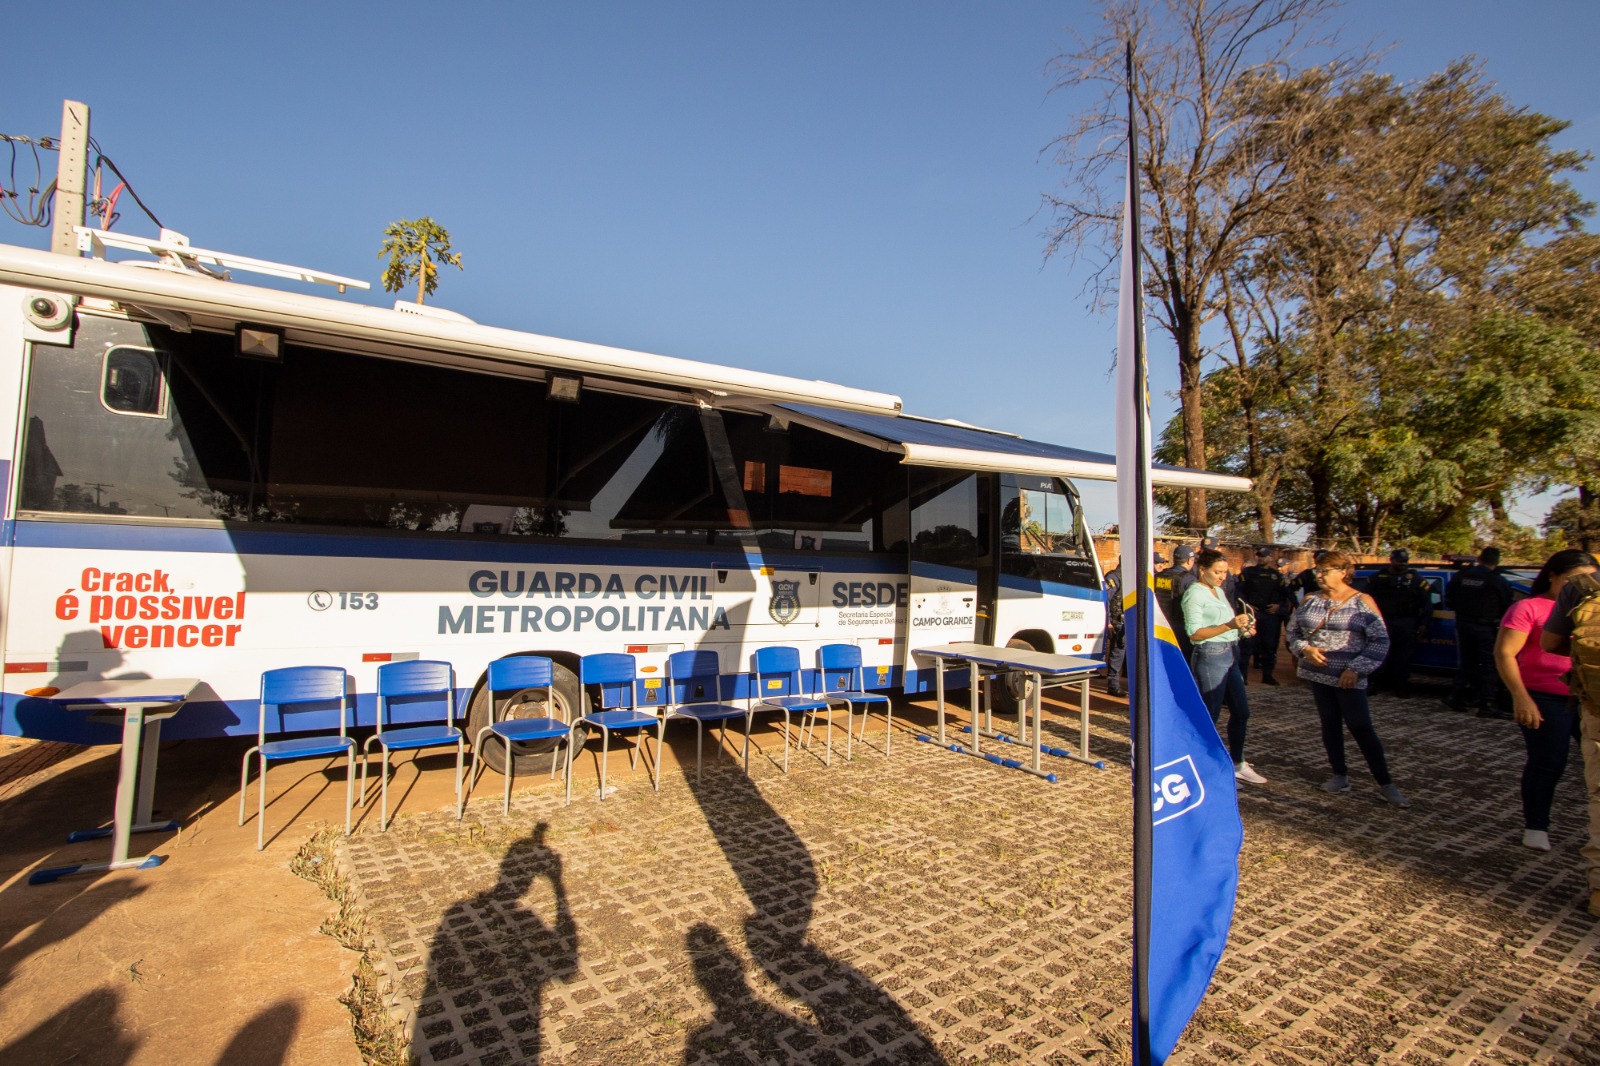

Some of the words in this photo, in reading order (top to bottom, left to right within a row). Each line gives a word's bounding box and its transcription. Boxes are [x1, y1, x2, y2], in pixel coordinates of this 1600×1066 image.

[81, 567, 175, 594] Crack,
[468, 569, 626, 599] GUARDA
[634, 573, 713, 600] CIVIL
[778, 583, 794, 591] GCM
[55, 589, 79, 620] é
[338, 591, 379, 610] 153
[437, 605, 731, 635] METROPOLITANA
[847, 618, 879, 627] Segurança
[869, 610, 894, 618] Especial
[912, 617, 942, 627] CAMPO
[942, 616, 973, 626] GRANDE
[101, 624, 242, 649] vencer
